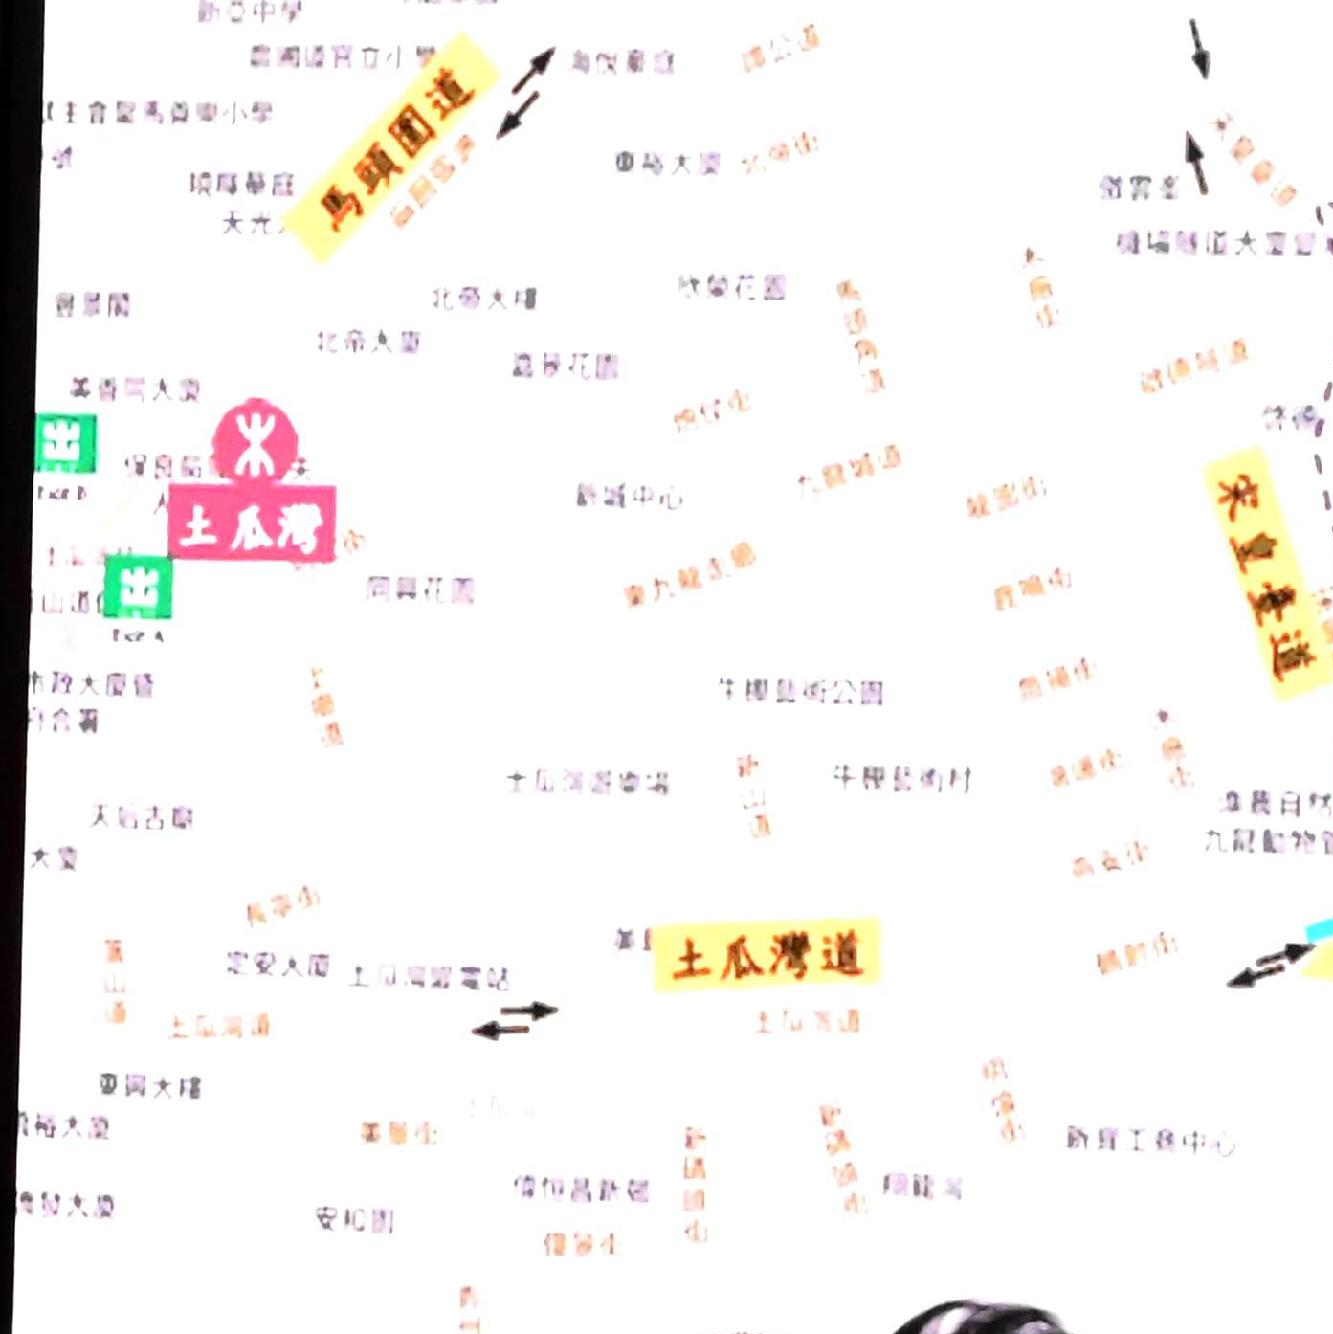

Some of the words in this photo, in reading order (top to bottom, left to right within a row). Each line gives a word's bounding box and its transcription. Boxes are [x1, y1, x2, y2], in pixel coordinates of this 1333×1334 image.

[318, 62, 478, 232] 馬頭圍道
[180, 503, 324, 554] 土瓜灣
[673, 929, 863, 982] 土瓜灣道
